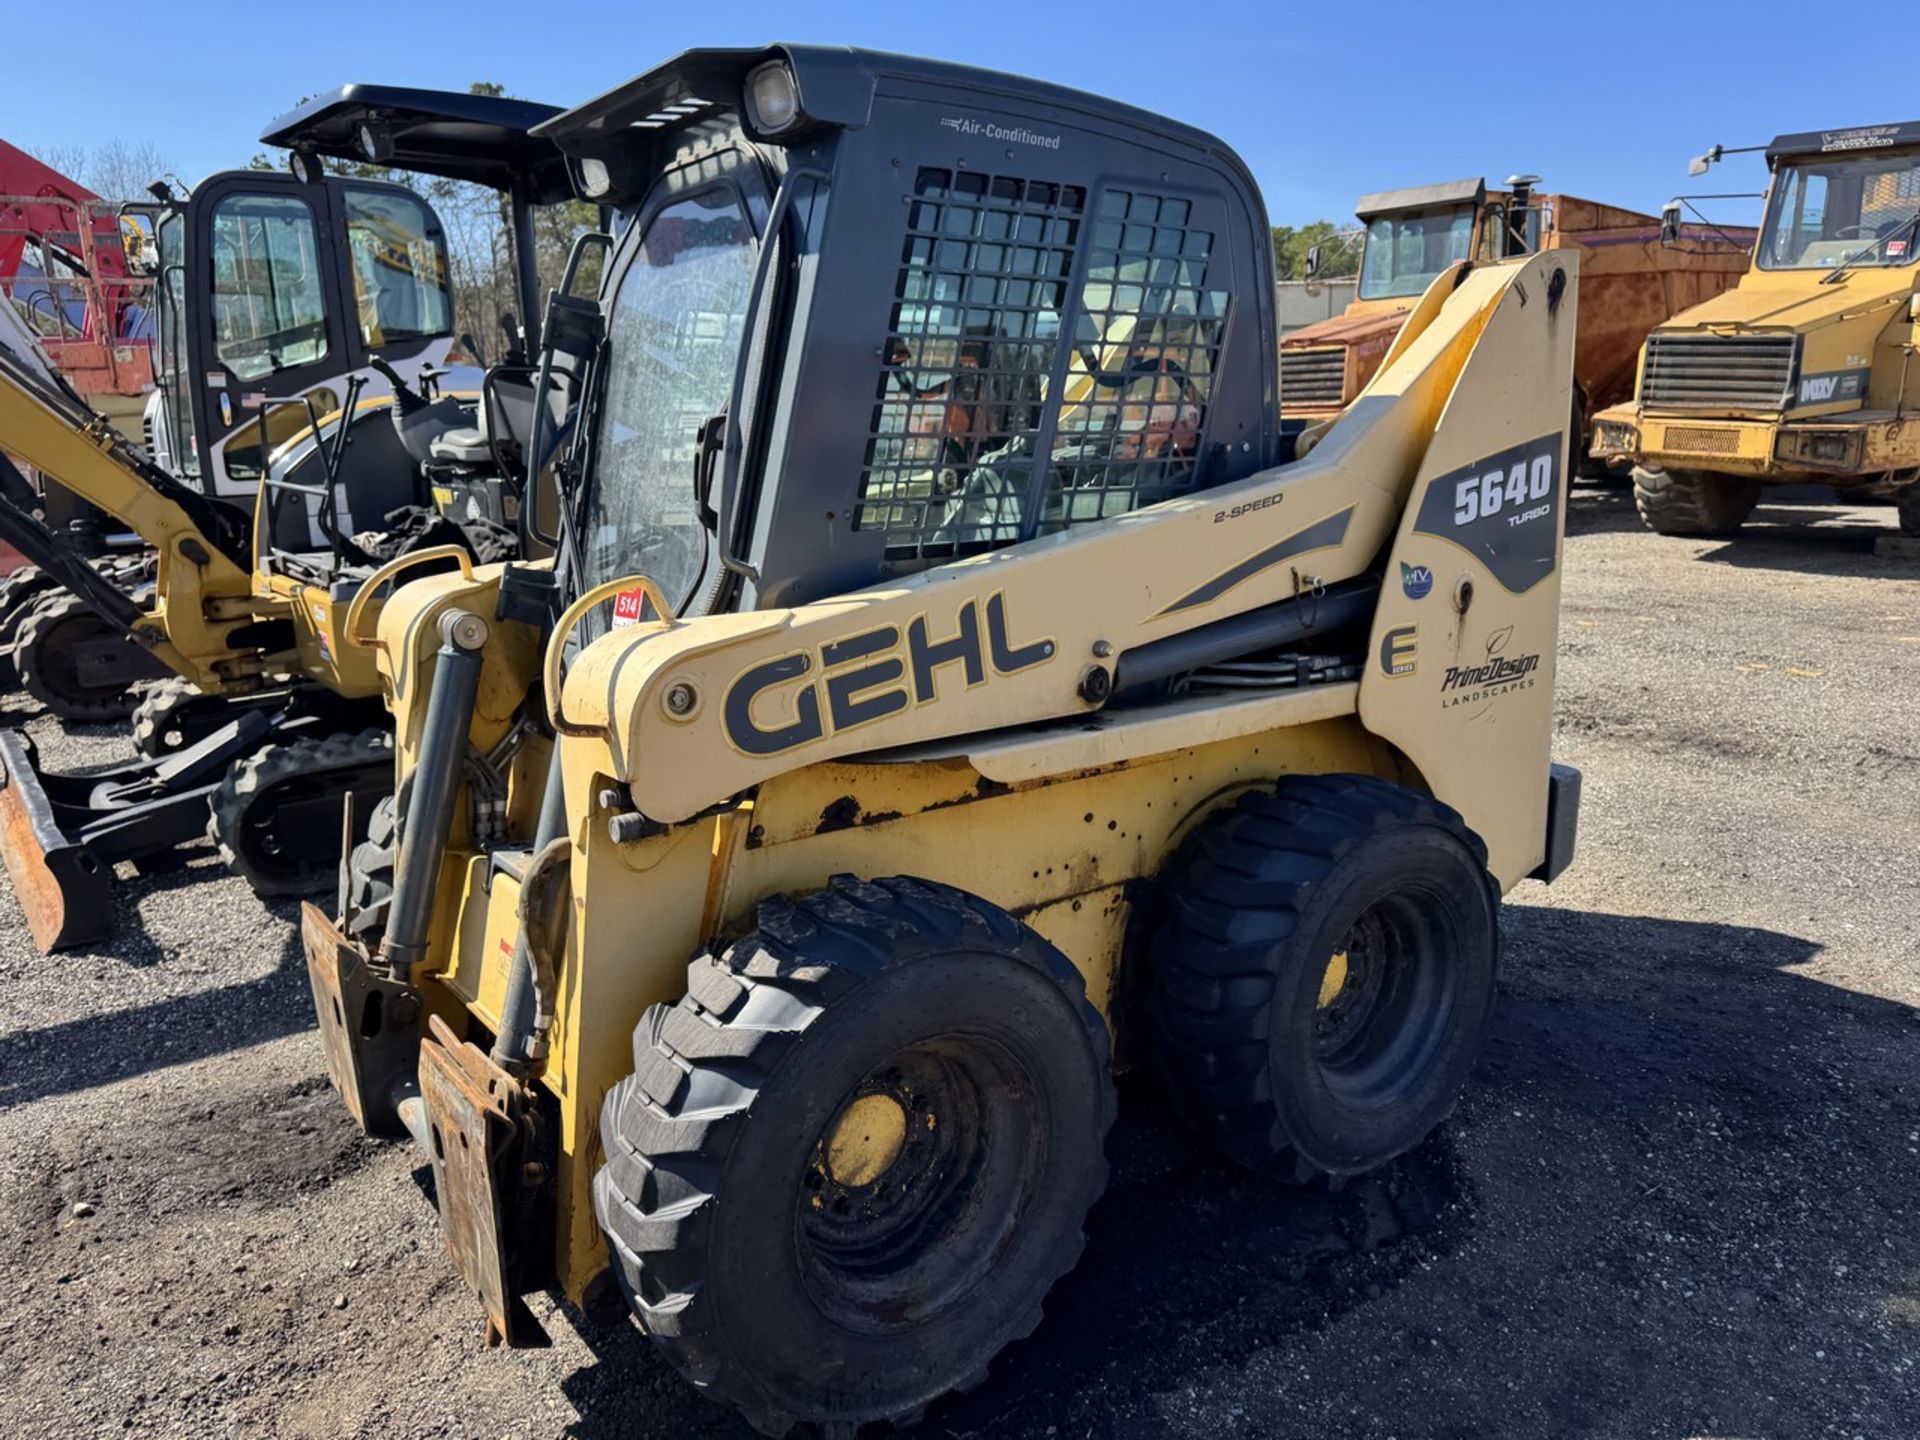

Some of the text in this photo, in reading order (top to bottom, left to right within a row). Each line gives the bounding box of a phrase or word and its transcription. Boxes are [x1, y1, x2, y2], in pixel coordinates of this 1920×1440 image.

[961, 119, 1060, 149] Air-Conditioned
[1454, 454, 1552, 526] 5640
[1214, 493, 1283, 524] 2-SPEED
[1508, 504, 1550, 528] TURBO
[618, 595, 638, 614] 514
[724, 590, 1056, 755] GEHL
[1442, 679, 1535, 708] LANDSCAPES
